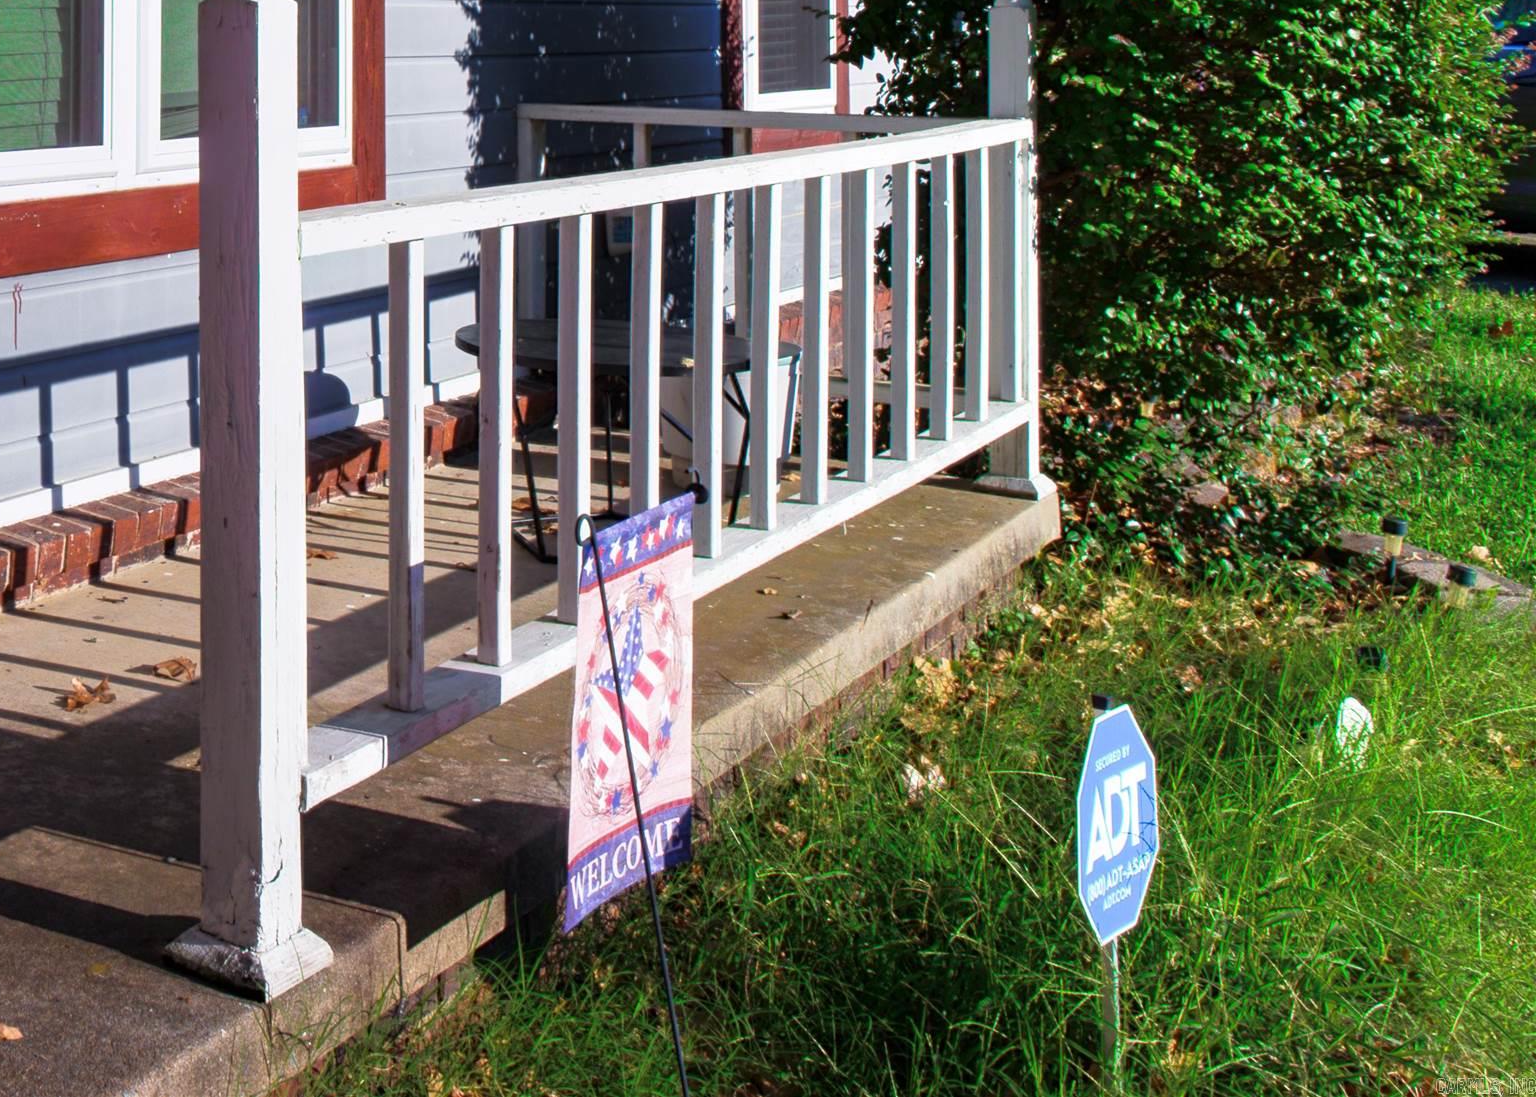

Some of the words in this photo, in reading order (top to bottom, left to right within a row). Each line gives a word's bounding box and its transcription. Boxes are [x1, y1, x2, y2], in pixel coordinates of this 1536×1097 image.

[1095, 748, 1122, 772] SECURED
[1121, 744, 1131, 759] BY
[1085, 761, 1146, 876] ADT
[570, 817, 683, 911] WELCOME
[1105, 852, 1152, 892] ADT-ASAP
